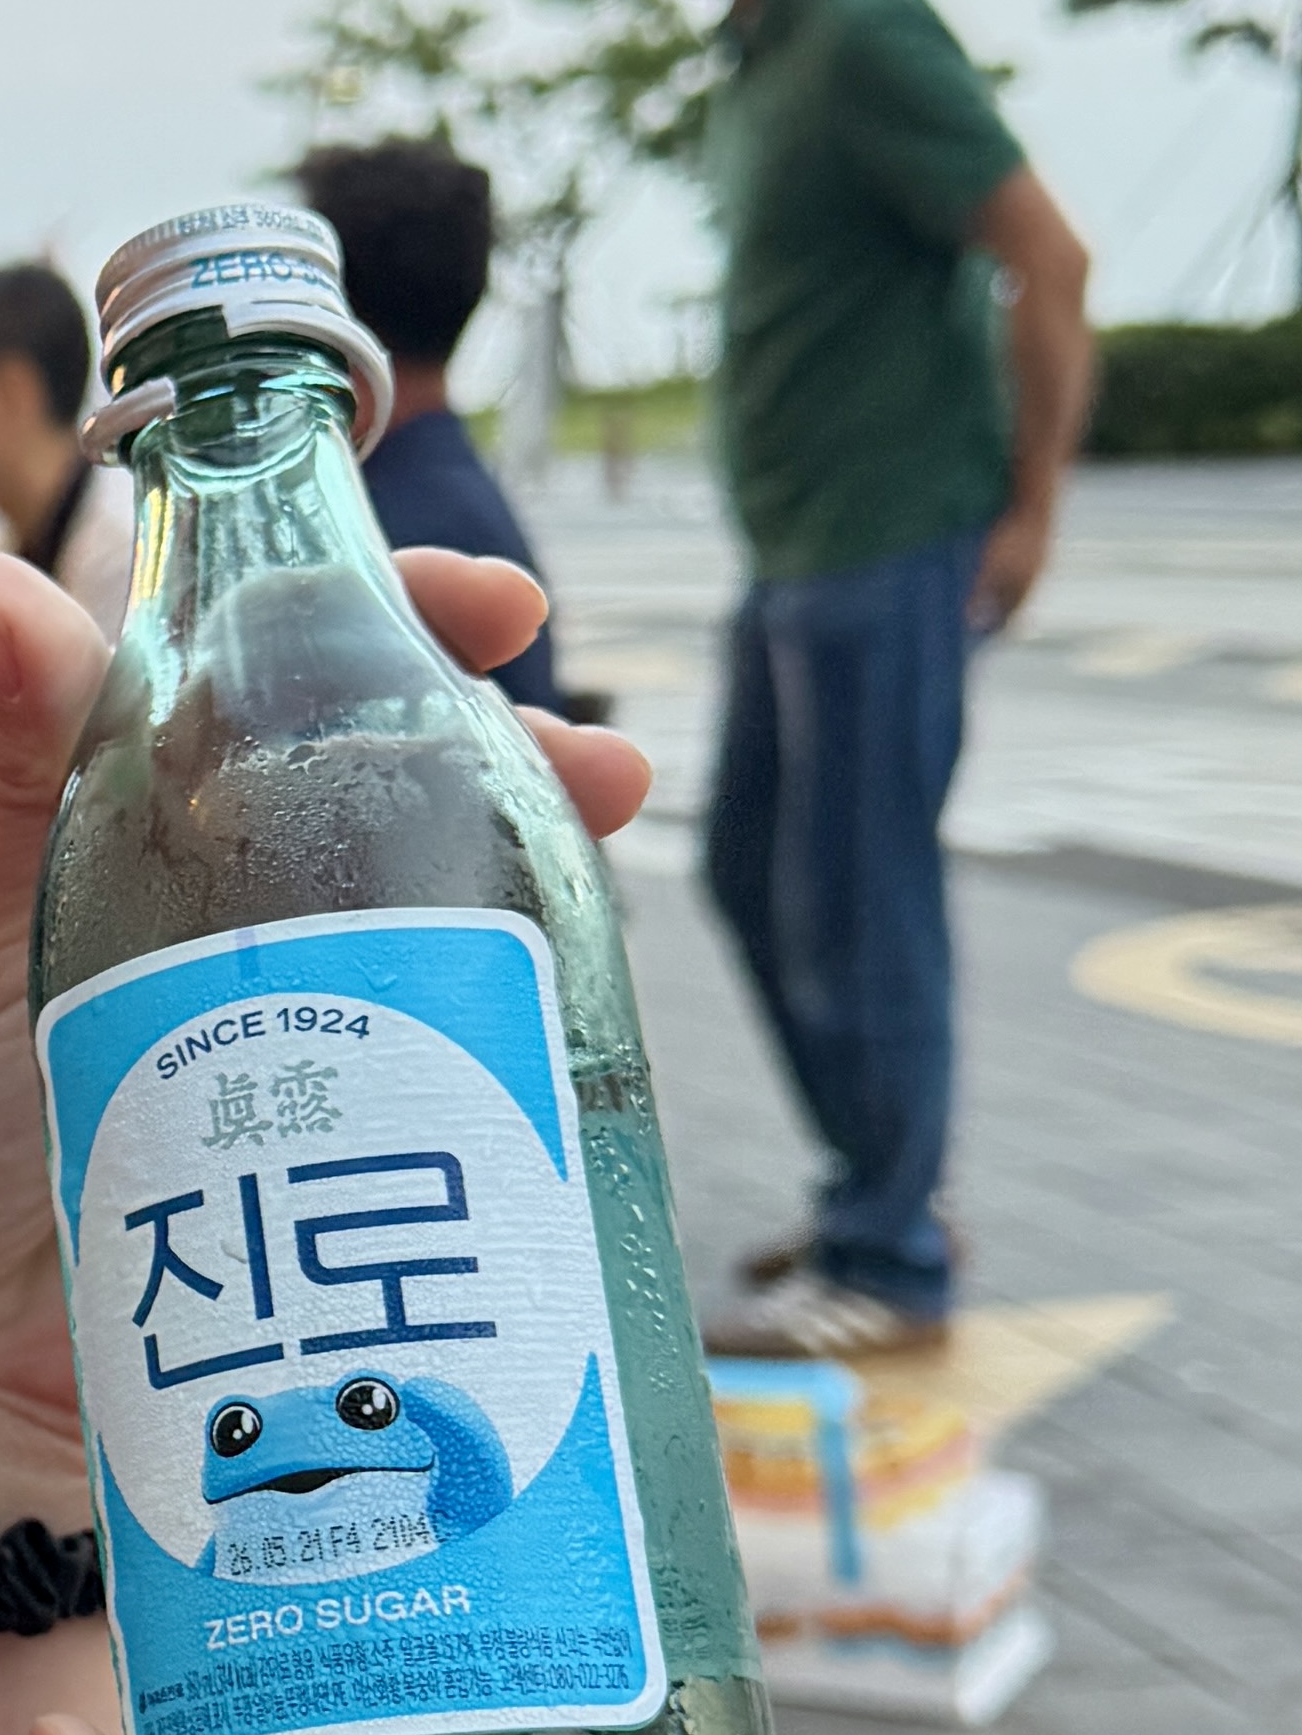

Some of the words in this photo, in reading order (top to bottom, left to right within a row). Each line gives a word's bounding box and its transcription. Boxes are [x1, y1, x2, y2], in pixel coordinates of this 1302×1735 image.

[190, 250, 292, 289] ZERO
[156, 1009, 267, 1081] SINCE
[276, 1006, 371, 1041] 1924
[200, 1060, 344, 1151] 眞露
[124, 1150, 497, 1391] 진로
[227, 1528, 324, 1576] 26.05.21
[205, 1605, 303, 1651] ZERO
[317, 1586, 472, 1632] SUGAR
